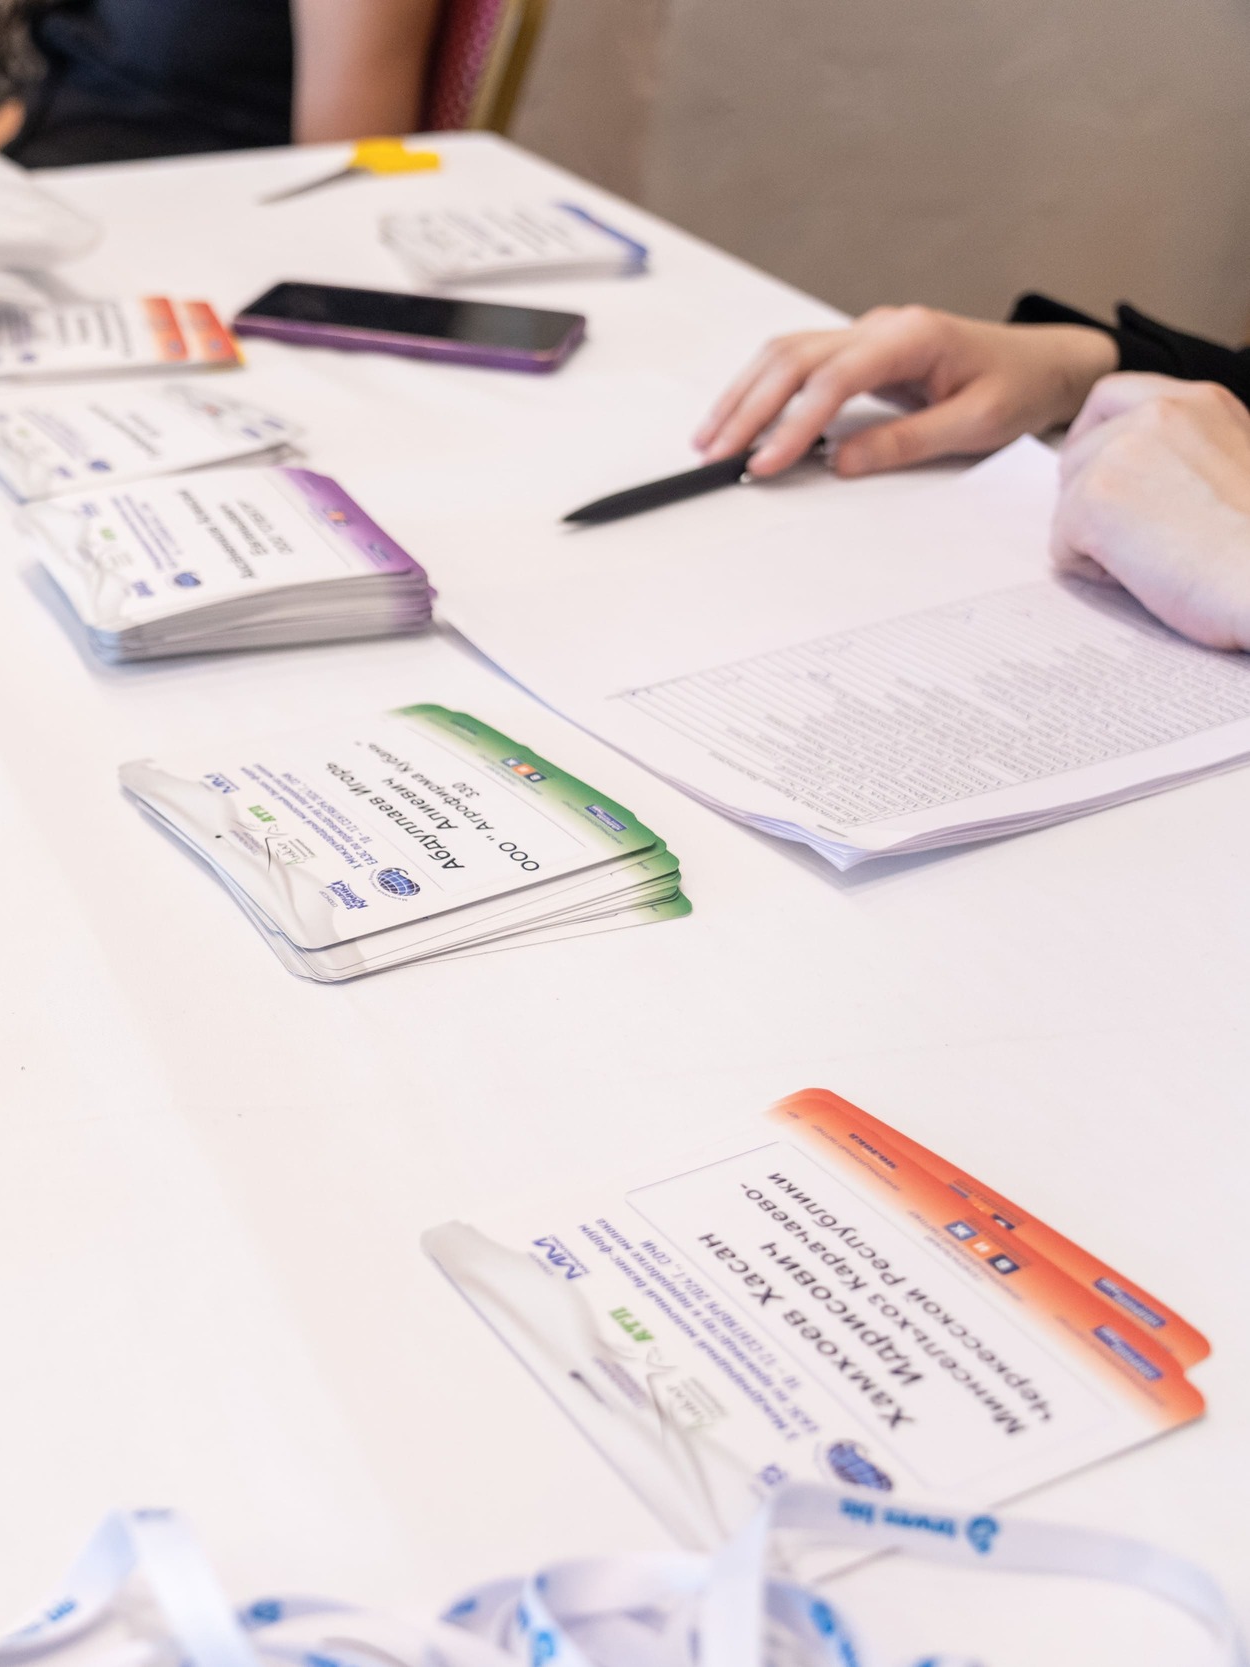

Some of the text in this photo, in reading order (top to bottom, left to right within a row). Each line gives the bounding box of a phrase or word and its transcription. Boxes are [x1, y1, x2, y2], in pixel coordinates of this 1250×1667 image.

[327, 763, 371, 795] Игорь
[384, 778, 457, 828] Алиевич
[412, 774, 492, 829] Агрофирма
[452, 783, 479, 797] 330
[370, 797, 463, 868] Абдуллаев
[499, 842, 538, 870] ООО
[580, 1225, 646, 1287] бизнес-форум
[596, 1218, 632, 1249] молока
[641, 1240, 670, 1263] СОЧИ
[742, 1185, 866, 1290] Карачаево-
[769, 1173, 904, 1284] Республики
[631, 1252, 692, 1307] переработке
[699, 1234, 782, 1304] Хасан
[644, 1289, 697, 1338] молочный
[705, 1301, 762, 1351] СЕНТЯБРЯ
[762, 1243, 921, 1384] Идрисович
[701, 1318, 772, 1386] производству
[784, 1310, 911, 1427] Хамхоев
[869, 1294, 1024, 1434] Минсельхоз
[906, 1289, 1050, 1420] Черкесской
[697, 1340, 787, 1429] Международный
